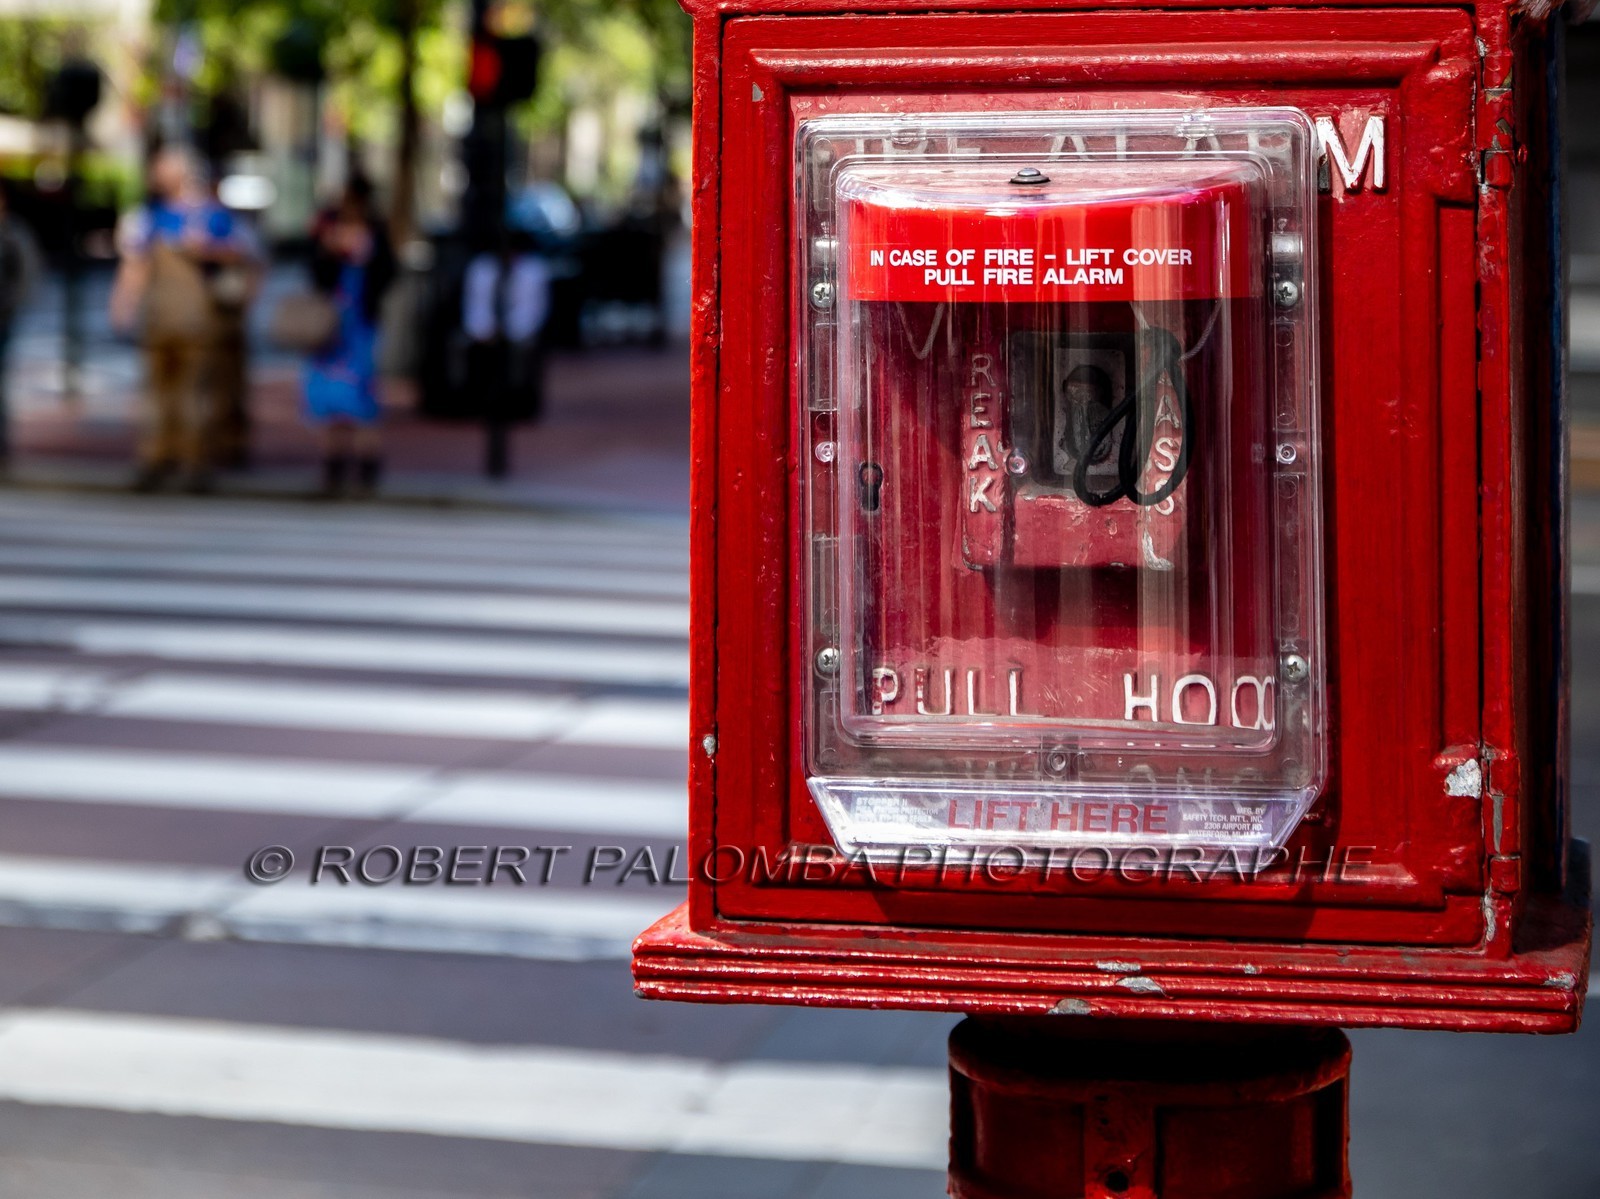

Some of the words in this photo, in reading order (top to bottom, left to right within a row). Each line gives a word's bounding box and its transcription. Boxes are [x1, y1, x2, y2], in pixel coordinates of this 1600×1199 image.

[870, 249, 884, 267] IN
[889, 249, 937, 267] CASE
[946, 248, 976, 266] OF
[984, 248, 1034, 266] FIRE
[1066, 248, 1114, 266] LIFT
[1123, 248, 1193, 266] COVER
[925, 268, 975, 286] PULL
[984, 268, 1033, 285] FIRE
[1043, 267, 1124, 285] ALARM
[968, 352, 999, 514] REAK
[871, 666, 1046, 717] PULL
[948, 799, 1038, 832] LIFT
[1050, 802, 1169, 834] HERE
[1182, 812, 1207, 822] SAFETY
[1208, 813, 1229, 823] TECH.
[1250, 814, 1264, 824] INC.
[1221, 822, 1251, 832] AIRPORT
[1251, 823, 1264, 832] RD.
